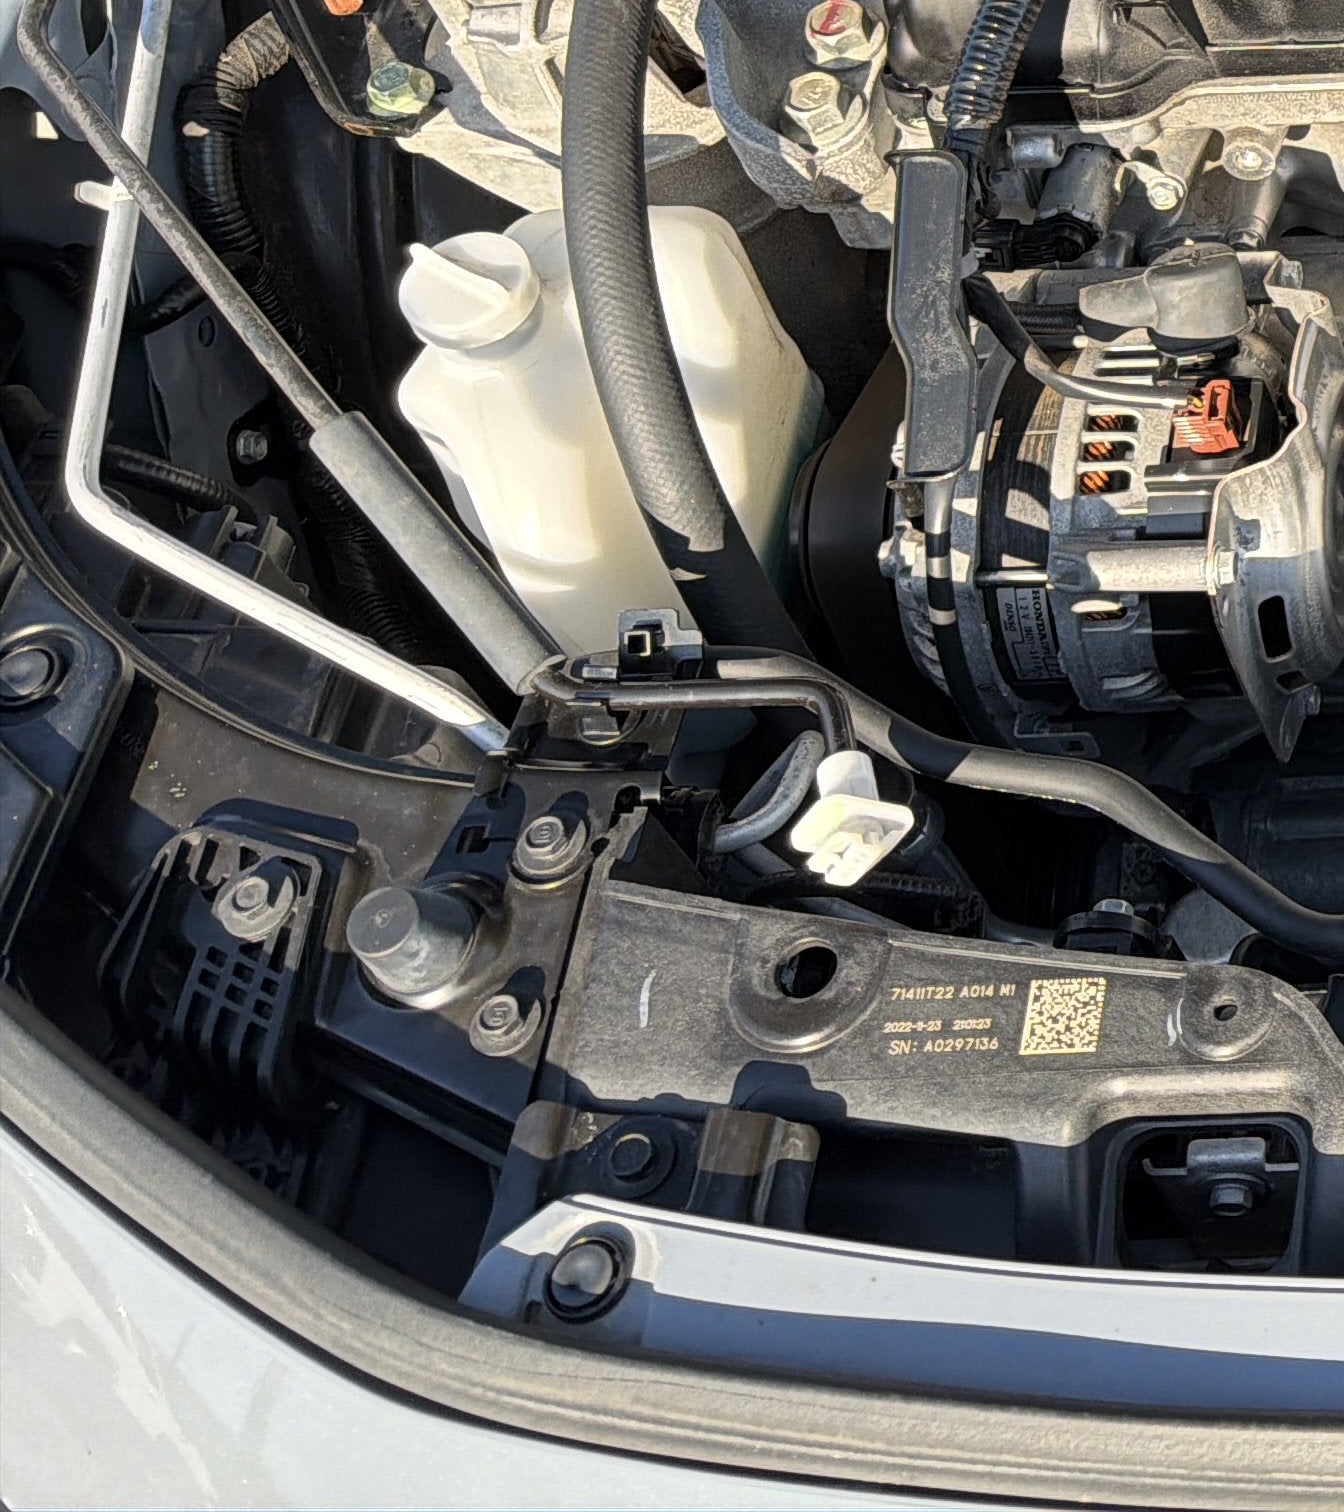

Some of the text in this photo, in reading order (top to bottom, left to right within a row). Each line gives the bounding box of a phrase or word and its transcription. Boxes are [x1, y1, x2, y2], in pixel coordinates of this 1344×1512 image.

[1004, 602, 1017, 633] DENSO
[1031, 589, 1047, 641] HONDA
[890, 985, 954, 1001] 71411T22
[958, 984, 994, 999] A014
[888, 1038, 999, 1056] SN: A0297136
